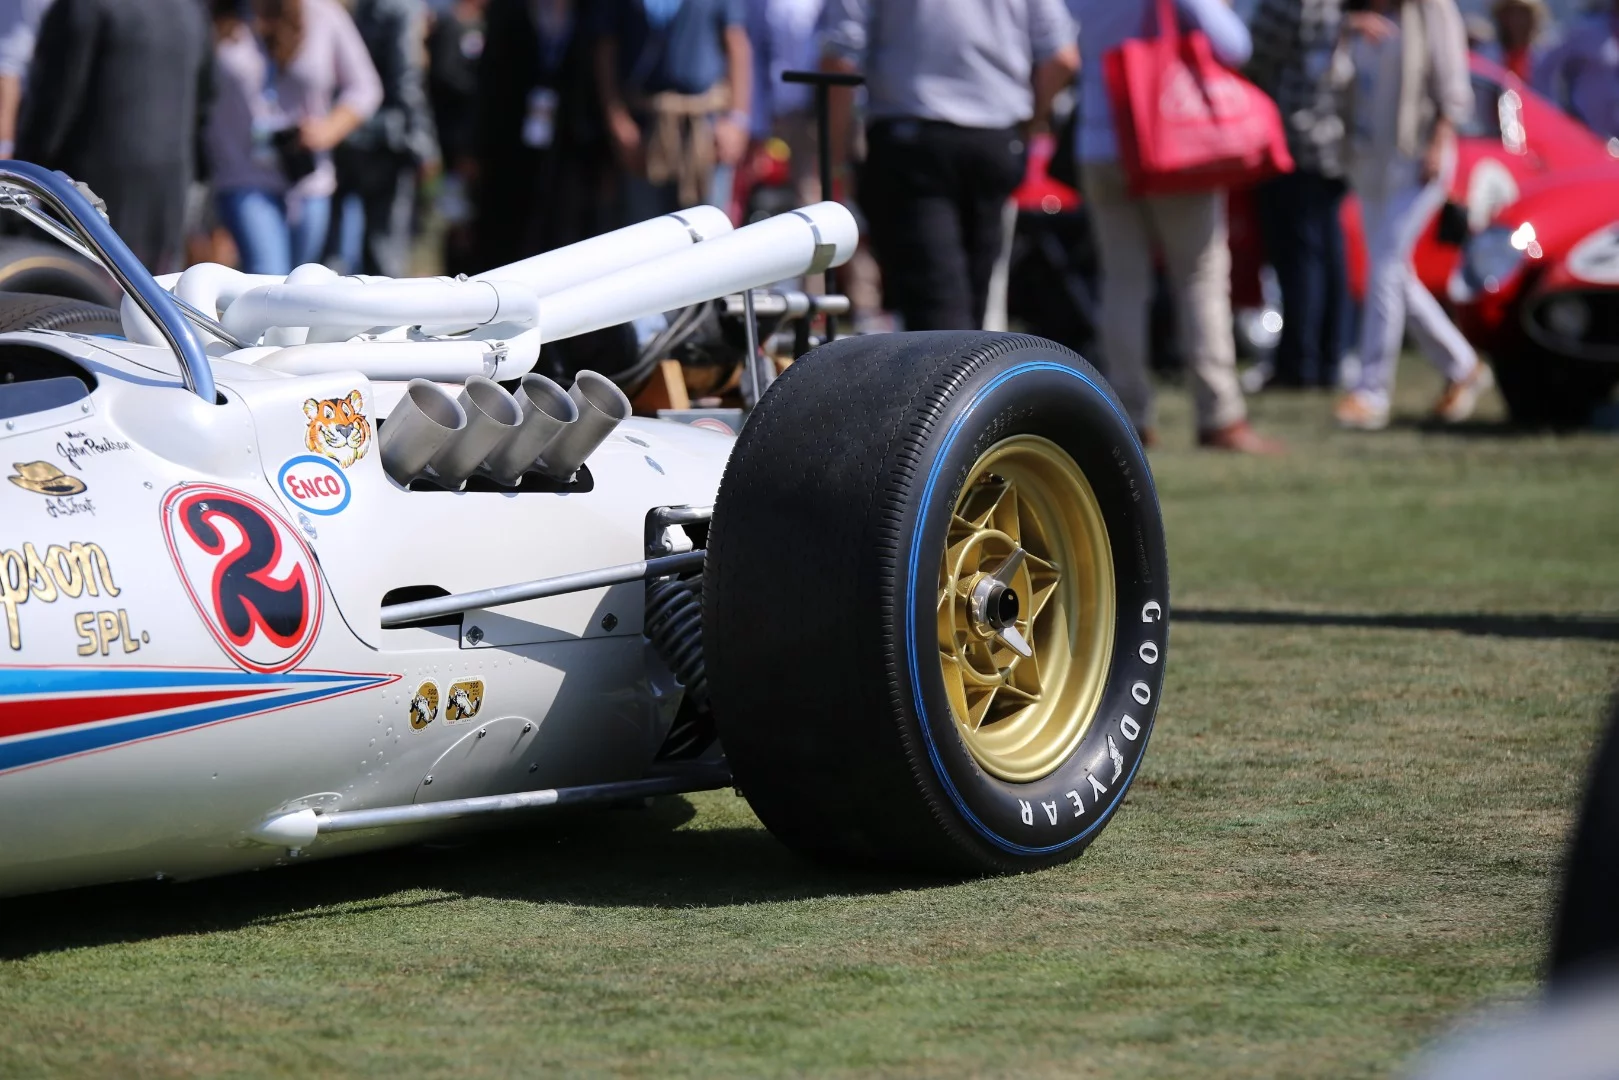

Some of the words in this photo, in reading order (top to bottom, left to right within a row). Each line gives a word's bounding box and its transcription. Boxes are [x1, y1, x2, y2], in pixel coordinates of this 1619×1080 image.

[286, 475, 341, 499] ENCO
[0, 541, 122, 651] pson
[178, 492, 309, 649] 2
[74, 608, 150, 657] SPL.
[1018, 600, 1162, 827] GOODYEAR
